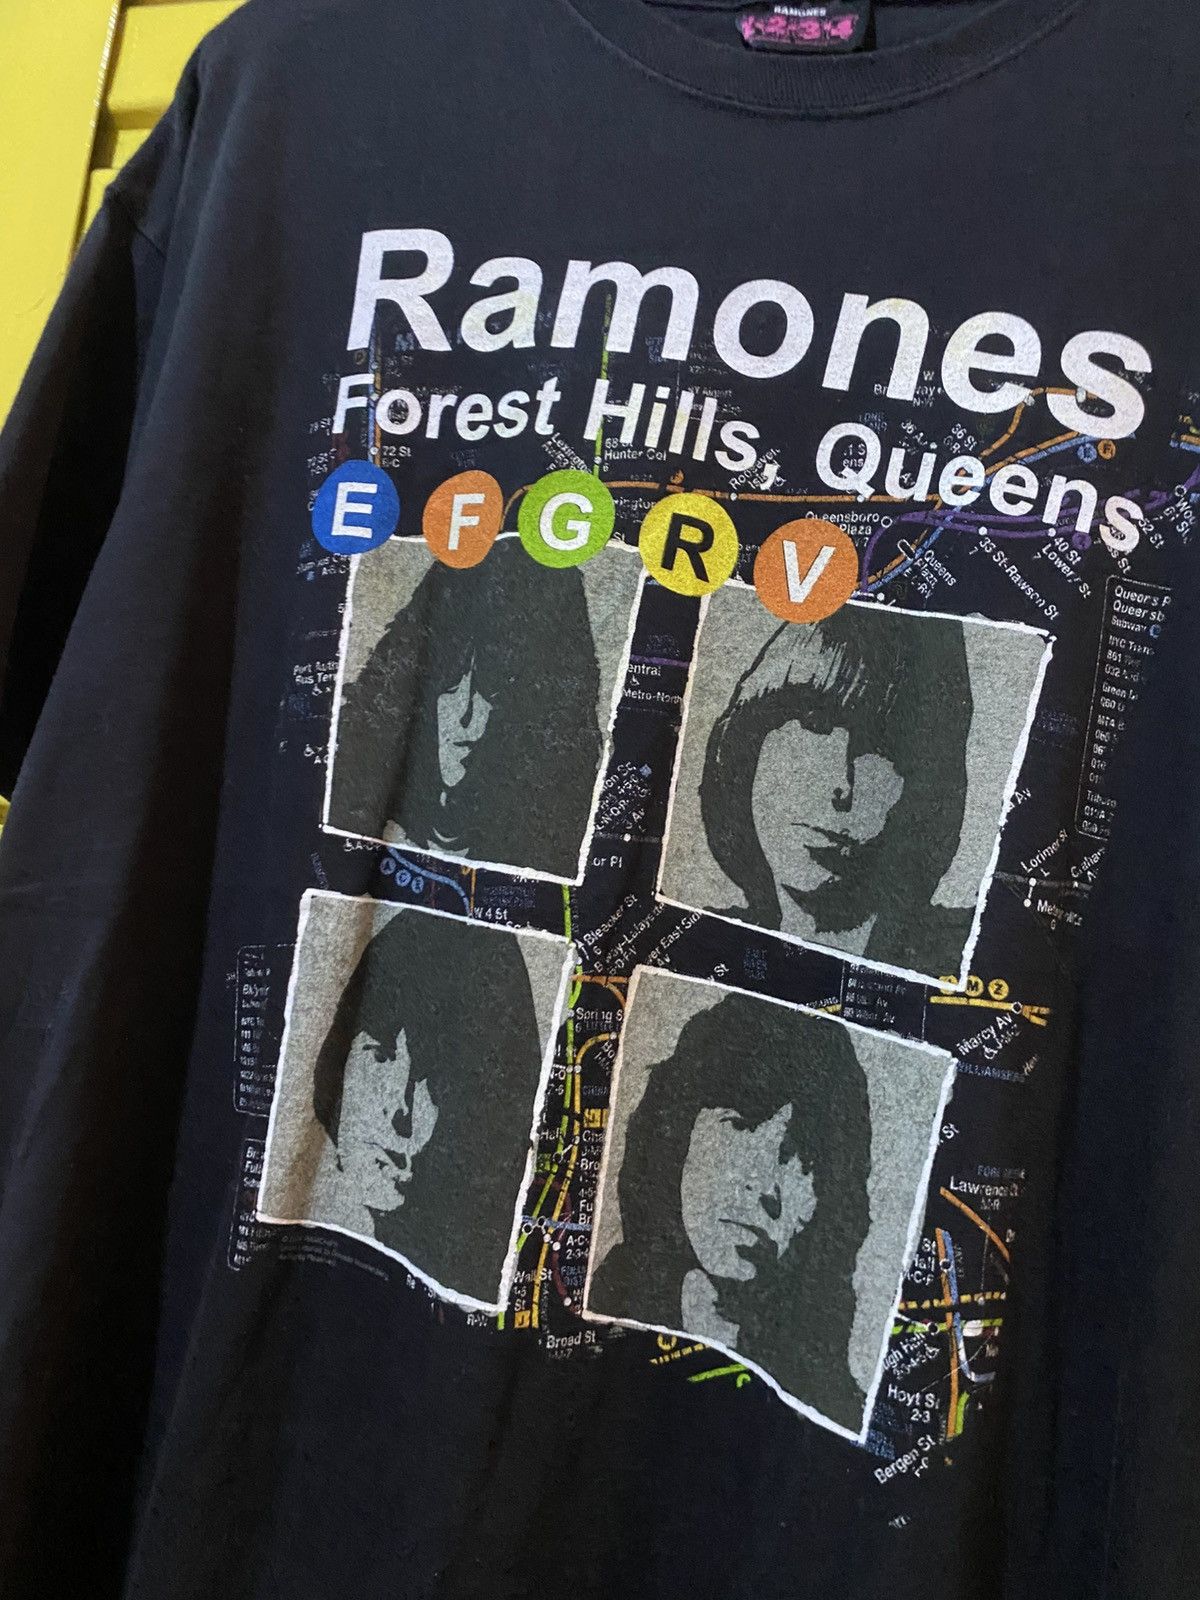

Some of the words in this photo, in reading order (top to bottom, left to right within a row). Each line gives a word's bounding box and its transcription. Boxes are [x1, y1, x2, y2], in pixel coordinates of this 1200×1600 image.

[347, 228, 1152, 440] Ramones
[332, 372, 560, 440] Forest
[816, 422, 1143, 552] Queens
[604, 449, 643, 461] Hunter
[646, 449, 667, 461] Col
[331, 482, 378, 538] E
[448, 492, 485, 551] F
[539, 492, 593, 551] G
[661, 512, 714, 583] R
[782, 538, 836, 603] V
[925, 550, 956, 586] Queens
[955, 1025, 997, 1056] Marcy
[546, 1333, 582, 1349] Broad
[873, 1446, 919, 1484] Bergen
